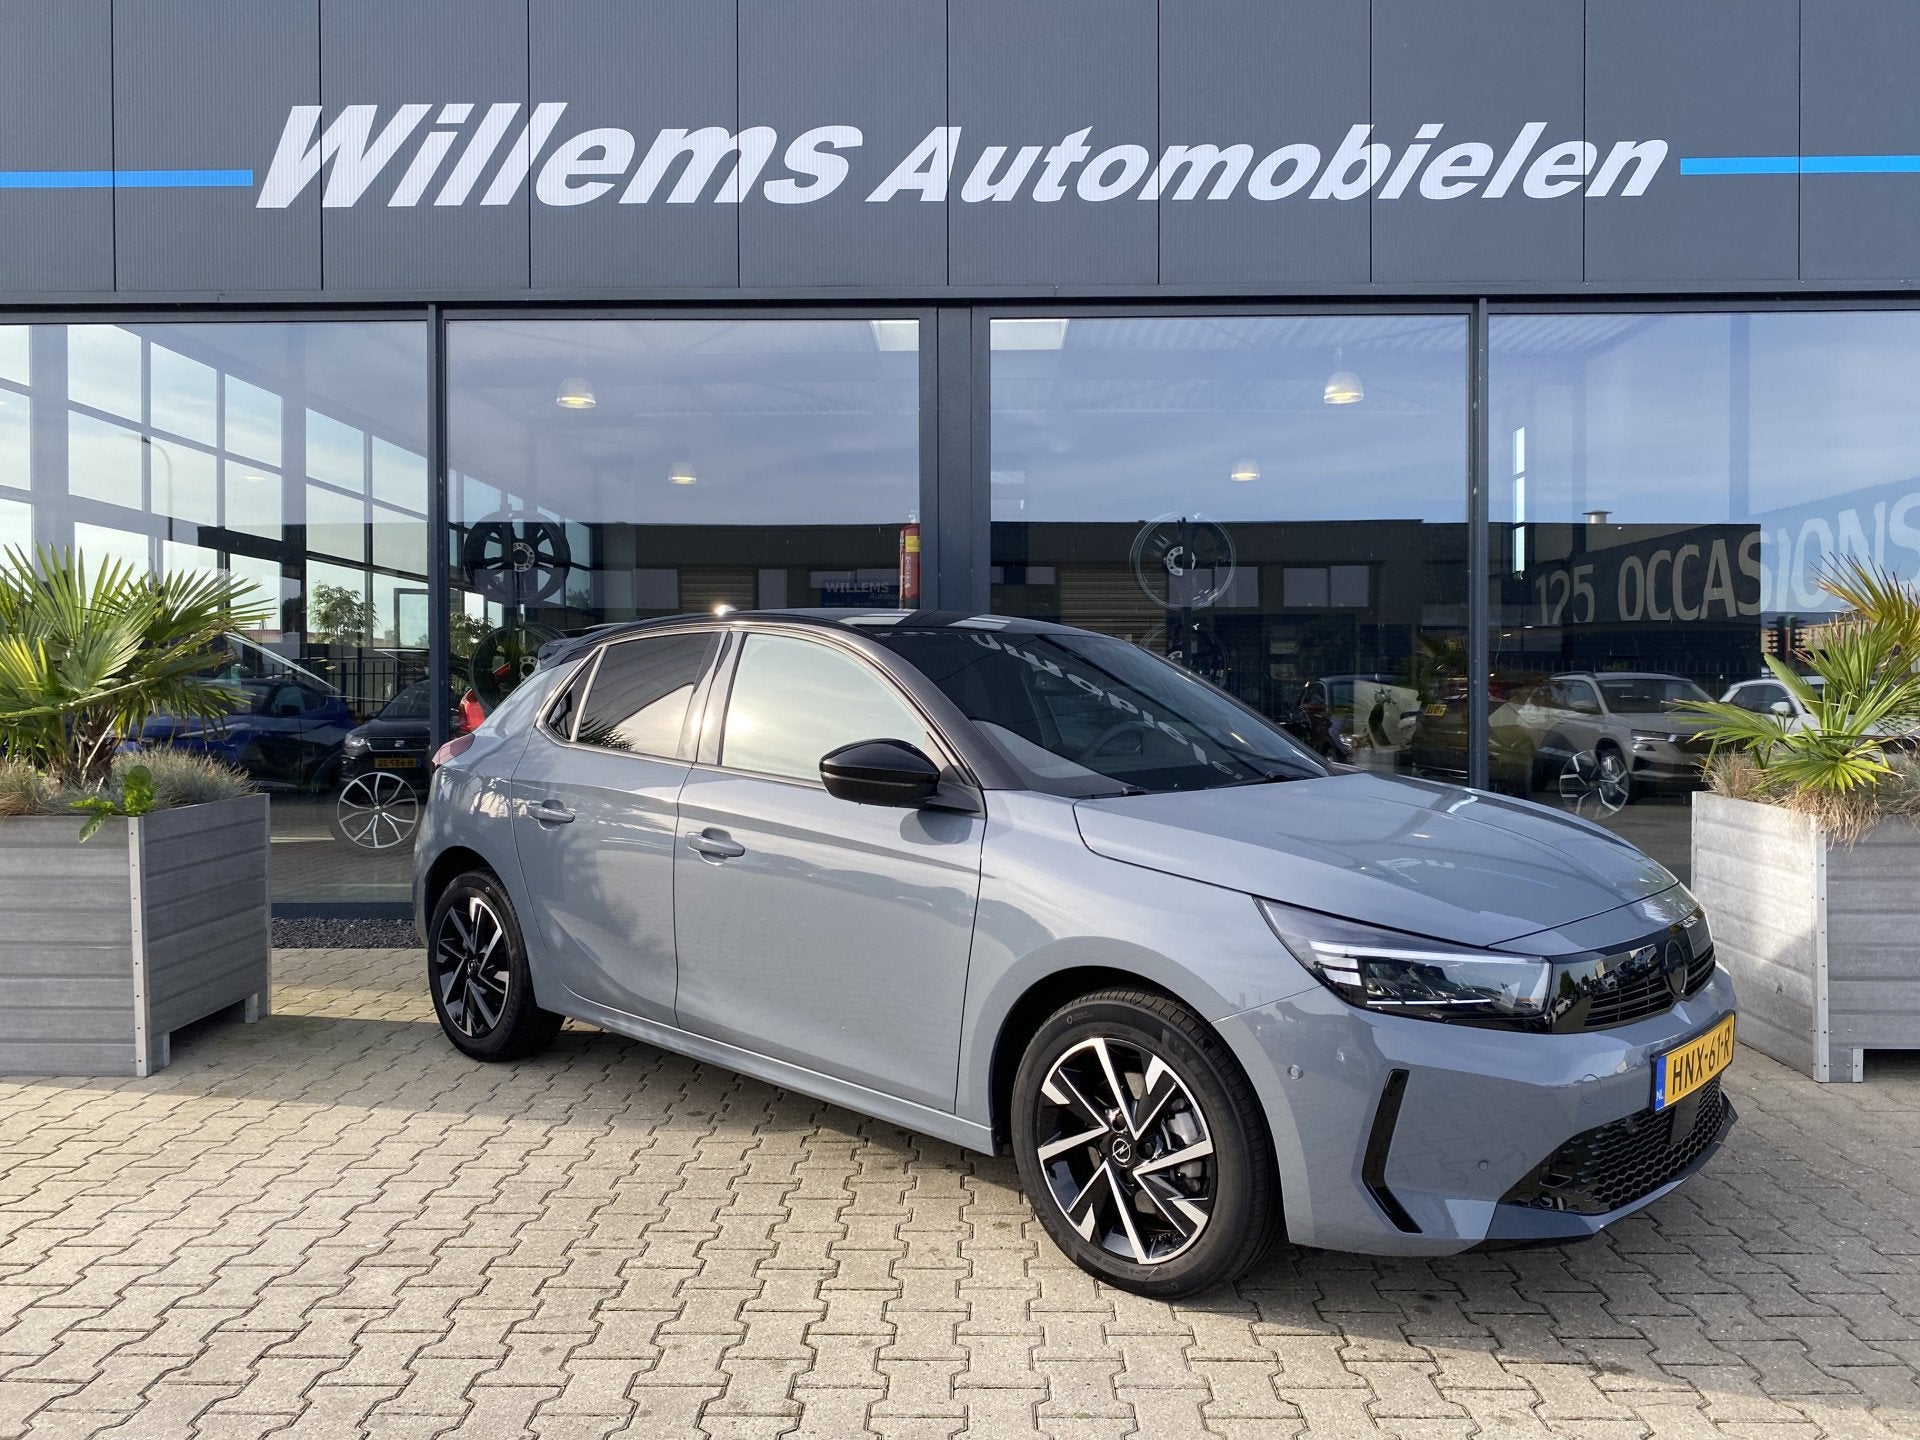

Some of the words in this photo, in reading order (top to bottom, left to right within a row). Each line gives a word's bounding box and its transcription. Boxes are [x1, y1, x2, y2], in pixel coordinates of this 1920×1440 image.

[256, 102, 863, 209] Willems
[866, 122, 1669, 202] Automobielen
[825, 582, 889, 593] WILLEMS
[1535, 564, 1596, 626] 125
[1672, 1025, 1731, 1095] HNX-61-R
